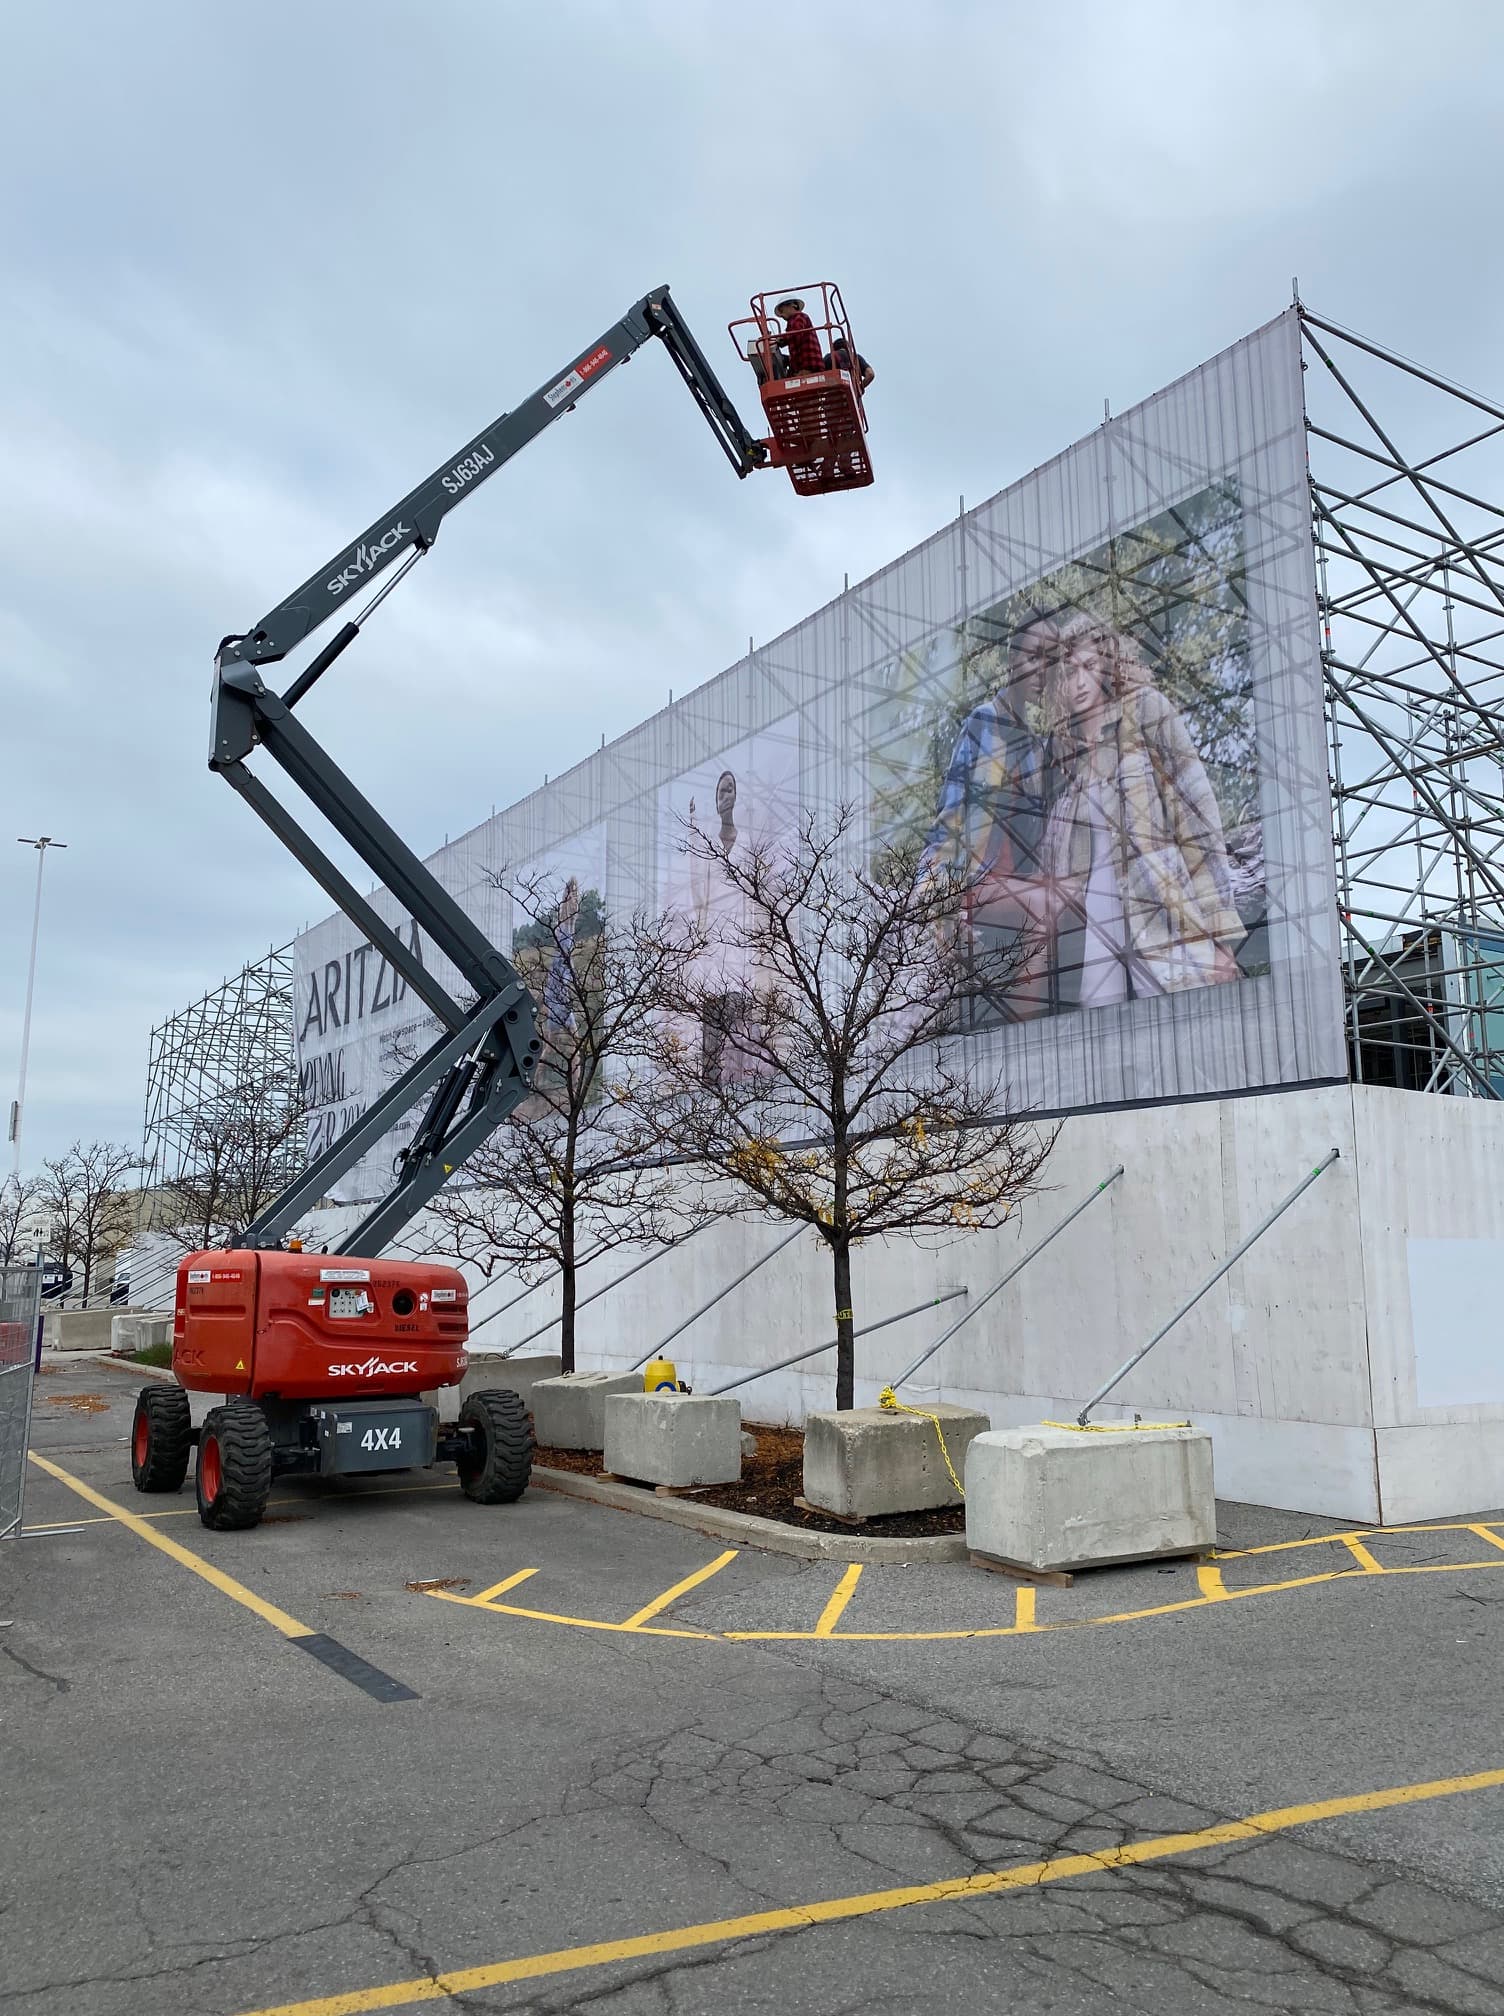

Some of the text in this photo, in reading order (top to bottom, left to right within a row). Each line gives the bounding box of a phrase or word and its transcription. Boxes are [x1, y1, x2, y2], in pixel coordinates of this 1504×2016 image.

[441, 444, 495, 494] SJ63AJ
[327, 521, 411, 596] SKYJACK
[327, 1356, 419, 1378] SKYJACK
[360, 1427, 402, 1451] 4X4
